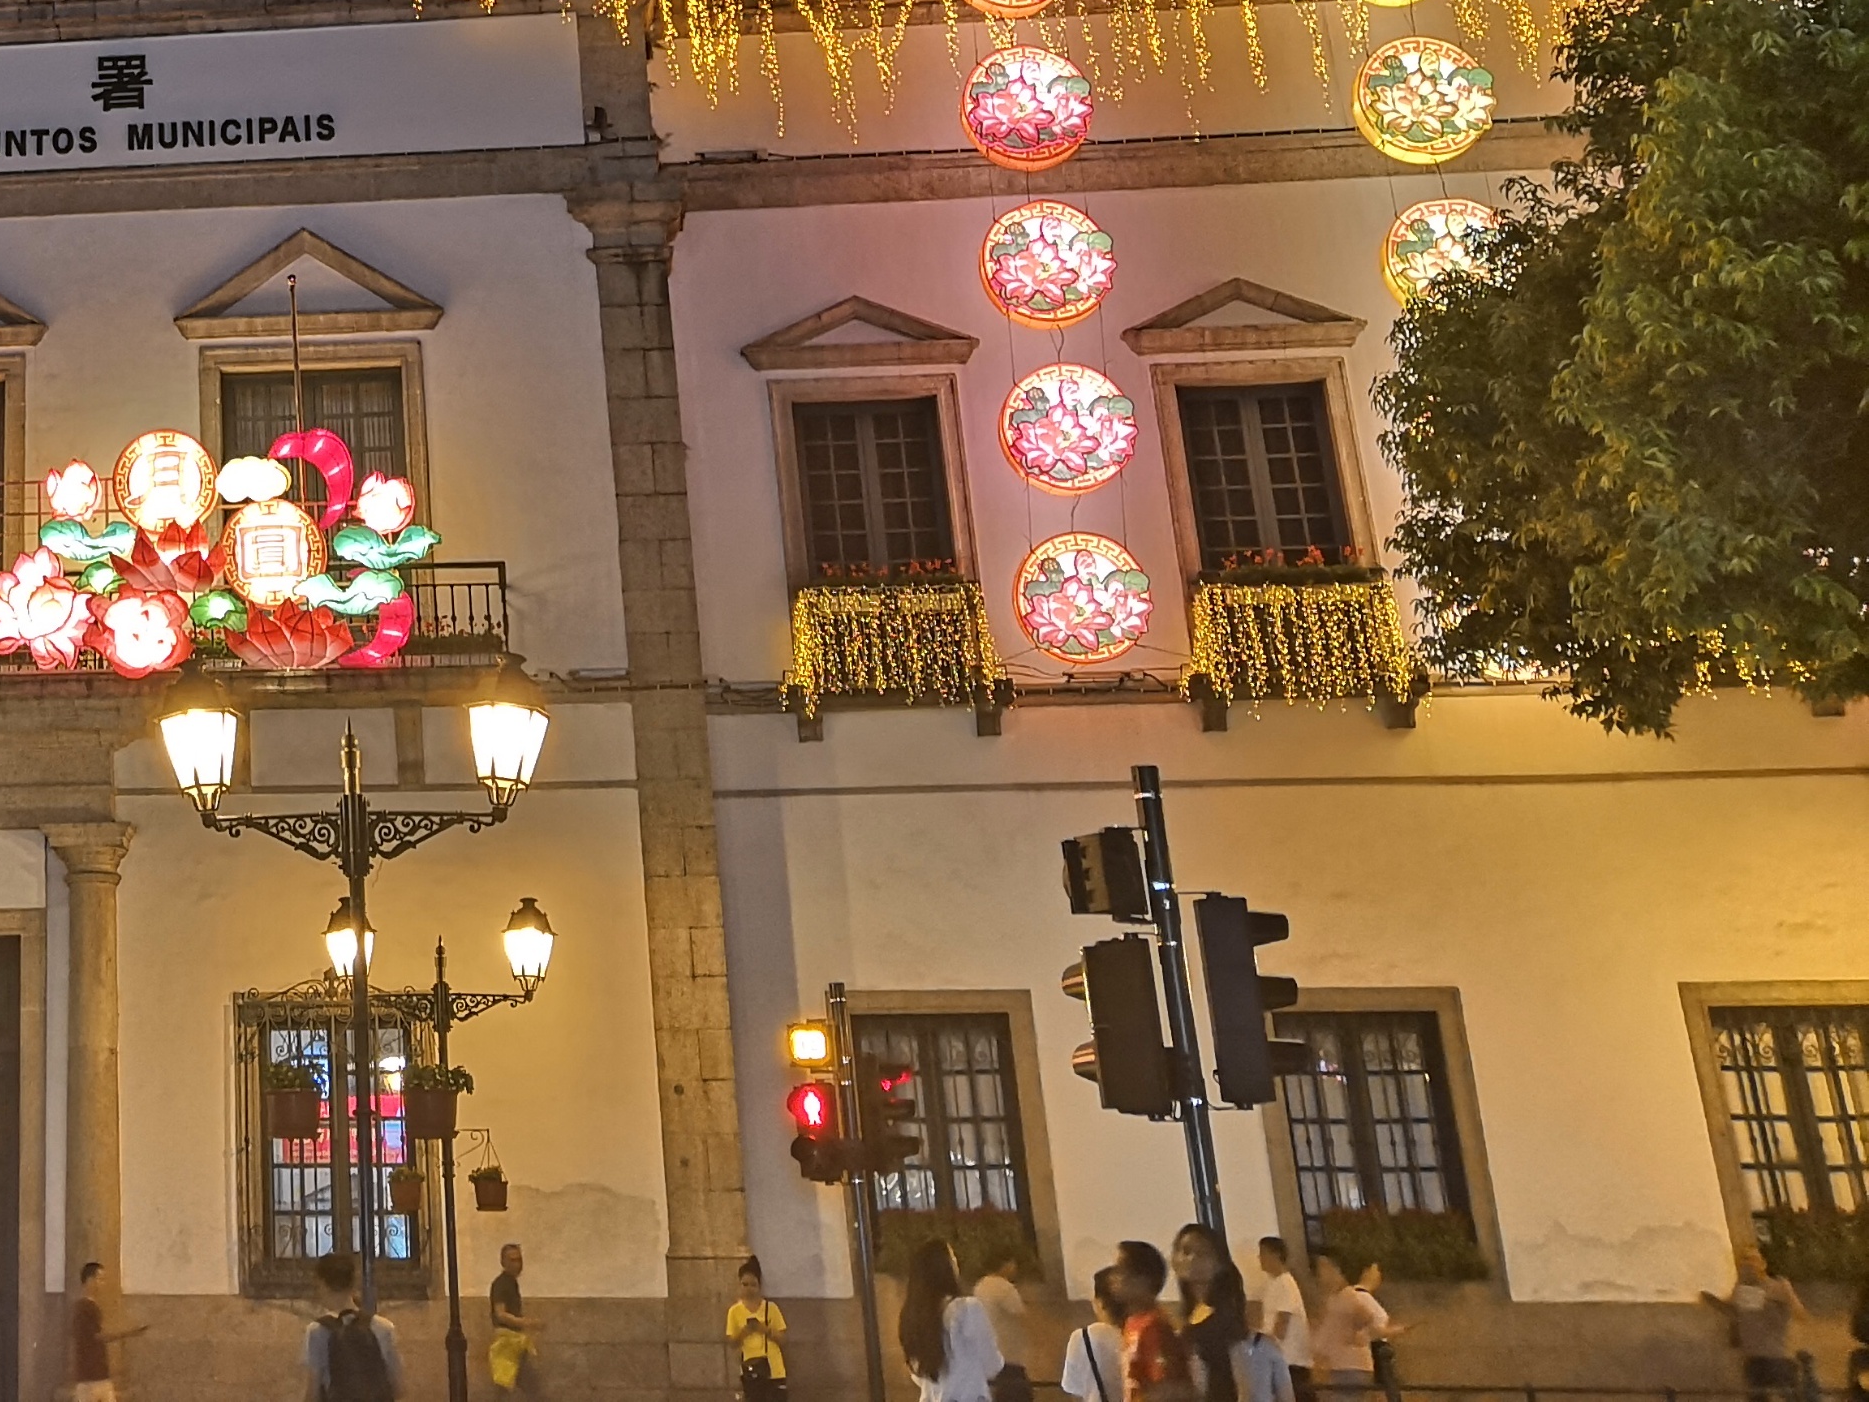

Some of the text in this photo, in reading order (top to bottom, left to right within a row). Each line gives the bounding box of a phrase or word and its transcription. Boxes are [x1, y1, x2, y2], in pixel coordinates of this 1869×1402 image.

[127, 113, 336, 154] MUNICIPAIS
[125, 450, 189, 508] 月
[238, 524, 304, 578] 圓
